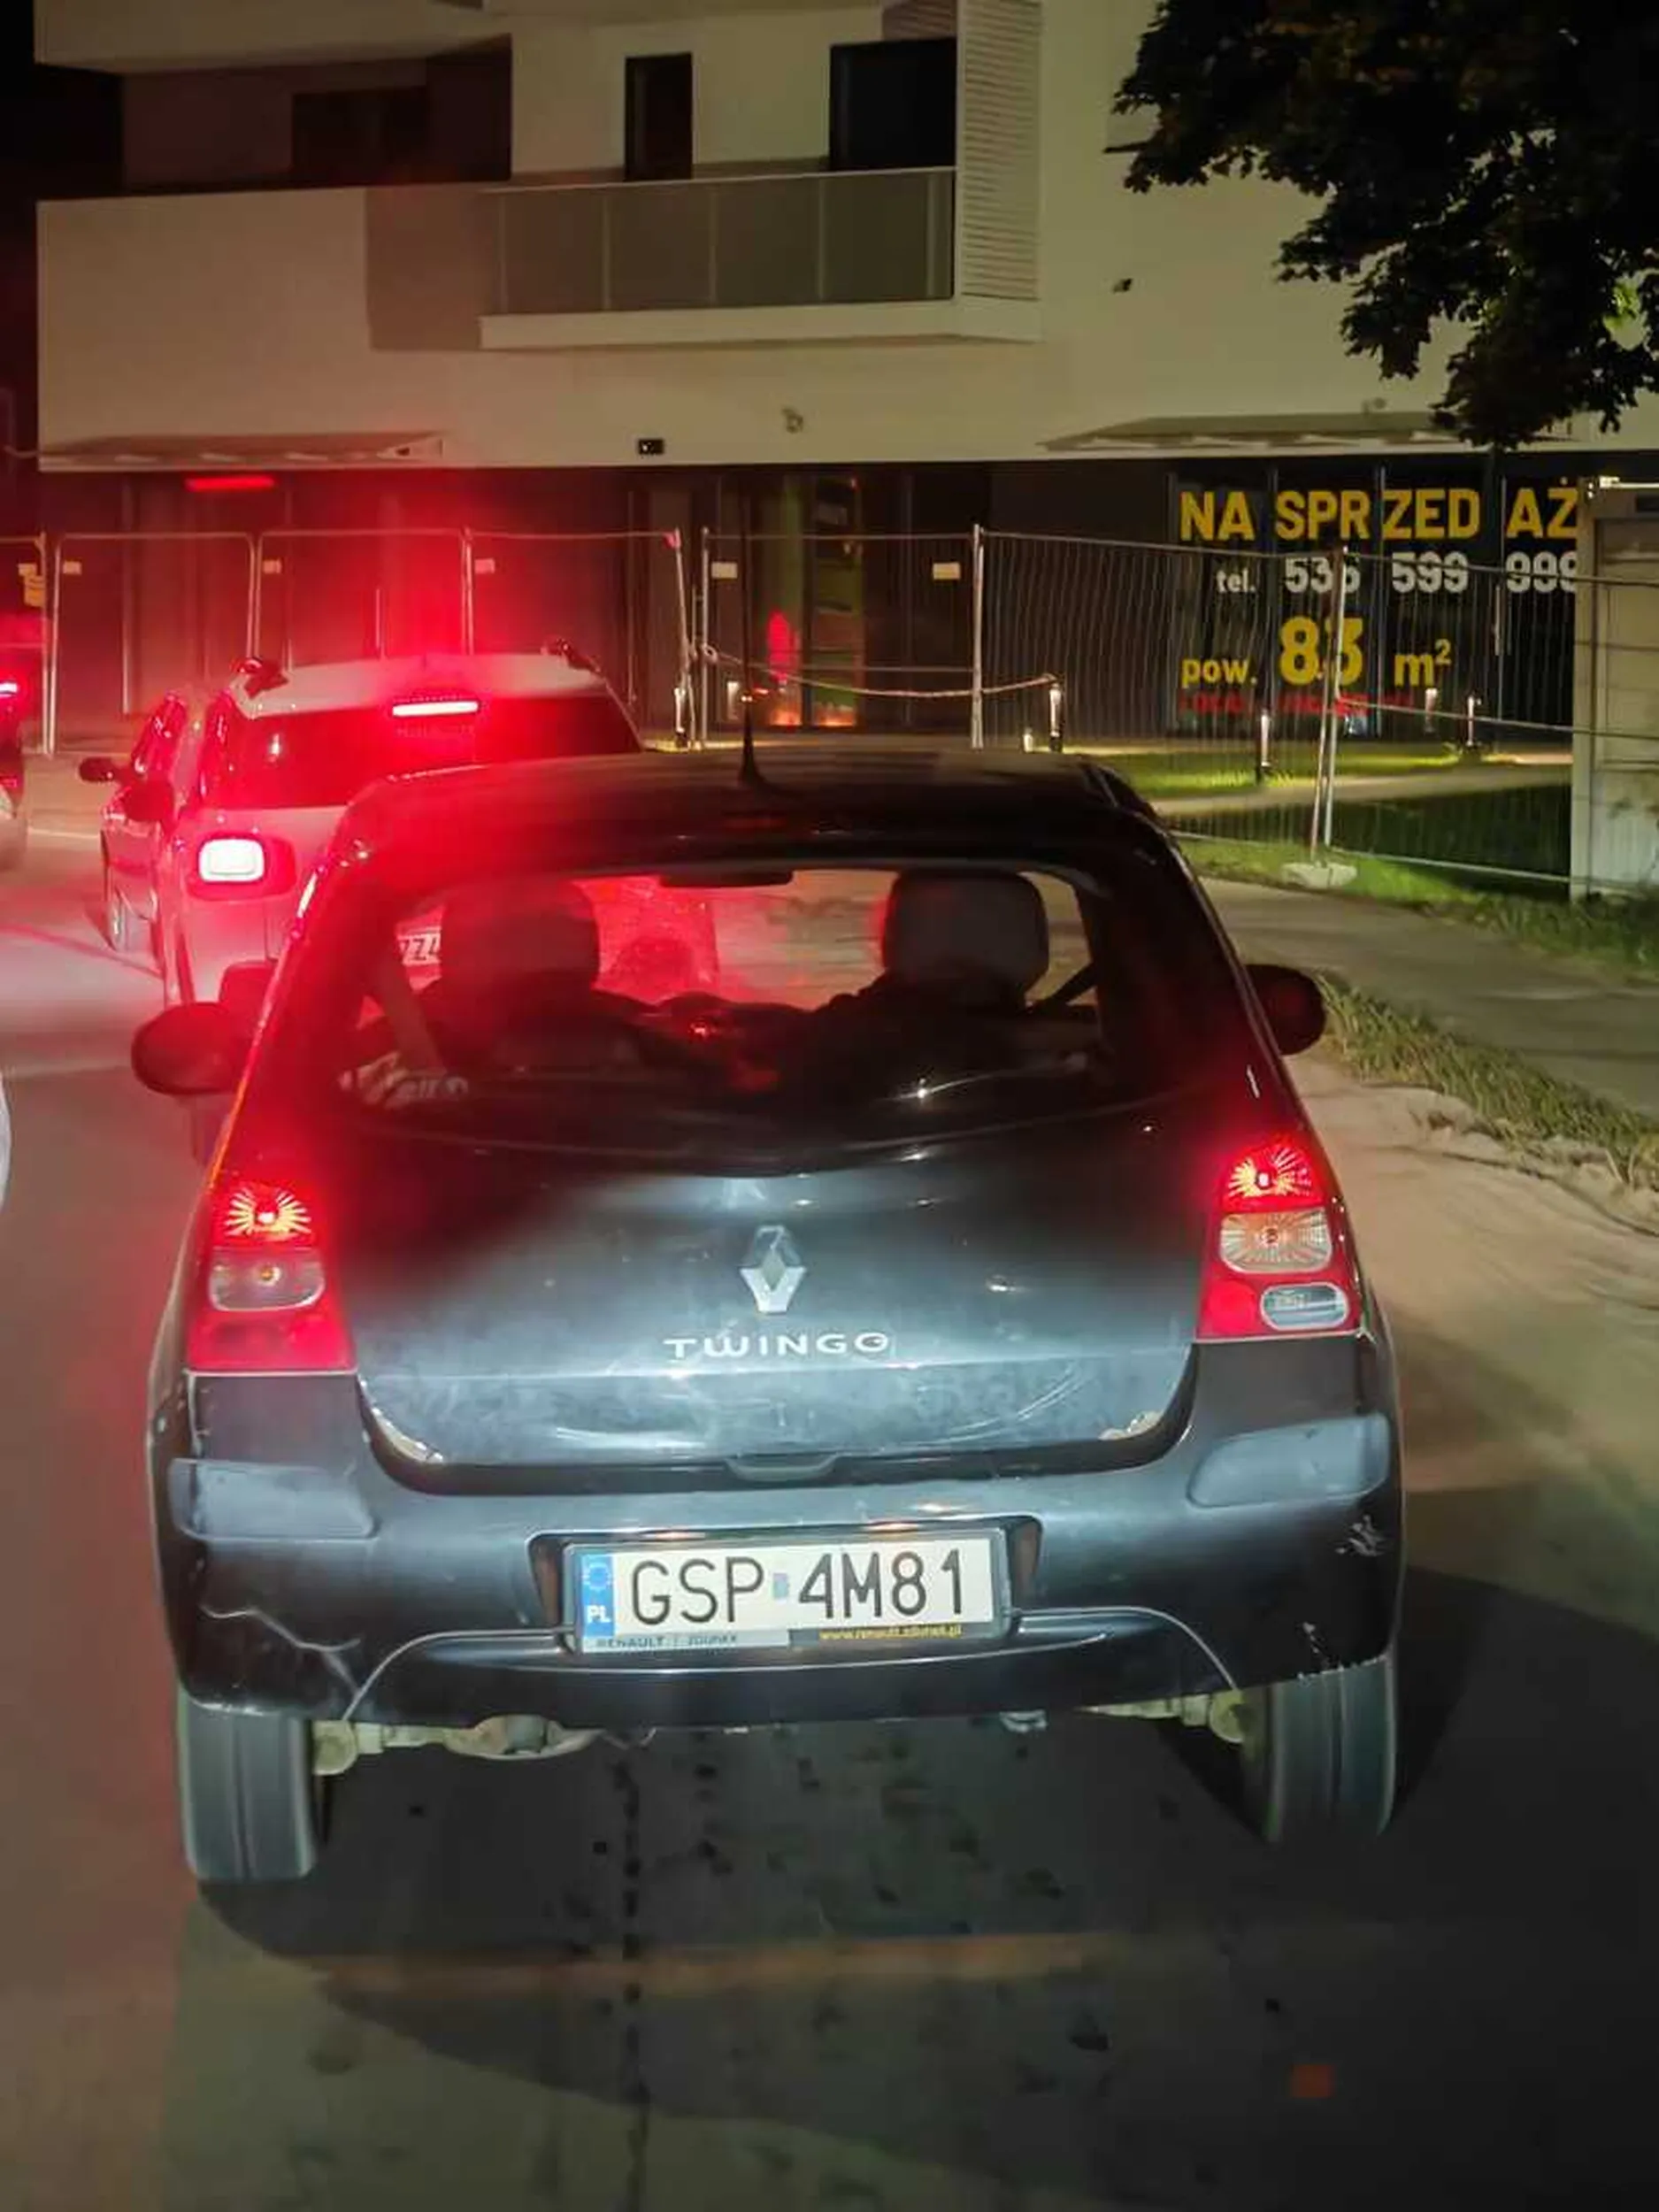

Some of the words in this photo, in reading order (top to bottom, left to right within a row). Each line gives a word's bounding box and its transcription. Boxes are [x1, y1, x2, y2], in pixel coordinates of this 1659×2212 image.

[1180, 489, 1256, 541] NA
[1216, 567, 1256, 593] tel.
[1392, 551, 1468, 593] 599
[1181, 658, 1257, 688] pow.
[664, 1332, 888, 1359] TWINGO
[632, 1555, 764, 1624] GSP
[798, 1548, 963, 1619] 4M81
[587, 1604, 611, 1624] PL
